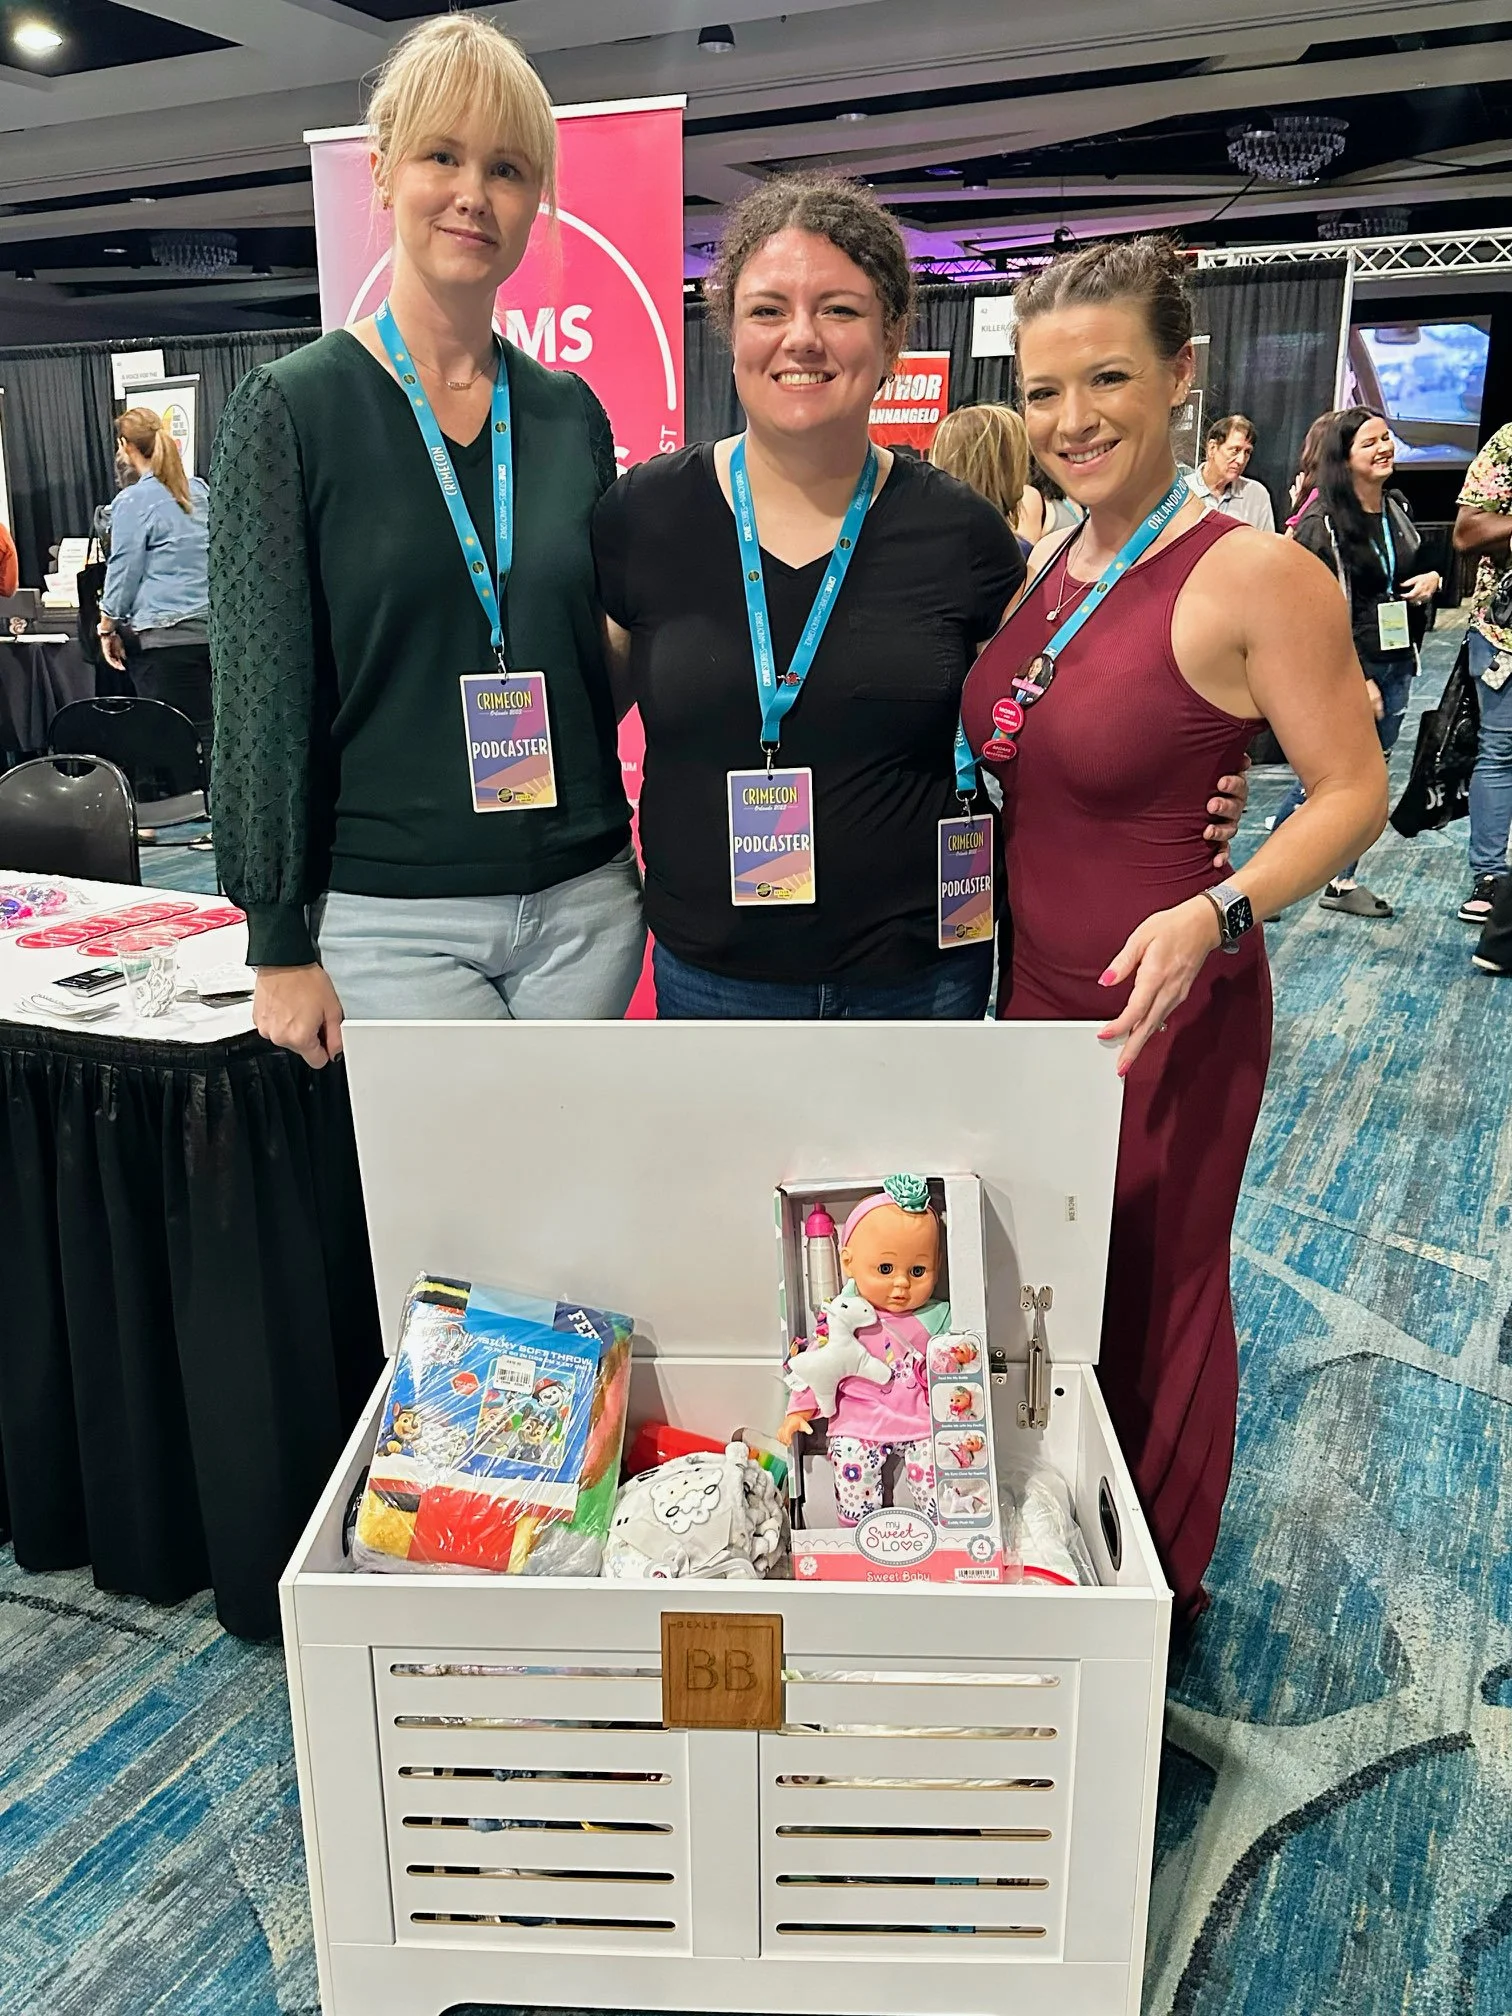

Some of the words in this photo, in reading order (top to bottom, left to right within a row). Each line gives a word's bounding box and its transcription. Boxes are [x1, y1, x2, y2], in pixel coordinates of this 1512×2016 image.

[491, 304, 593, 363] MS
[431, 447, 458, 496] CRIMECON
[1147, 488, 1182, 530] ORLANDO
[477, 691, 533, 710] CRIMECON
[471, 738, 548, 760] PODCASTER
[742, 786, 798, 805] CRIMECON
[734, 833, 810, 854] PODCASTER
[947, 831, 984, 852] CRIMECON
[941, 875, 991, 899] PODCASTER
[518, 1344, 549, 1357] SOFT
[550, 1352, 593, 1365] THROW
[866, 1522, 929, 1548] Sweet
[885, 1521, 900, 1530] my
[977, 1541, 985, 1551] 4
[867, 1571, 899, 1582] Sweet
[902, 1570, 931, 1582] Baby
[686, 1648, 758, 1691] BB
